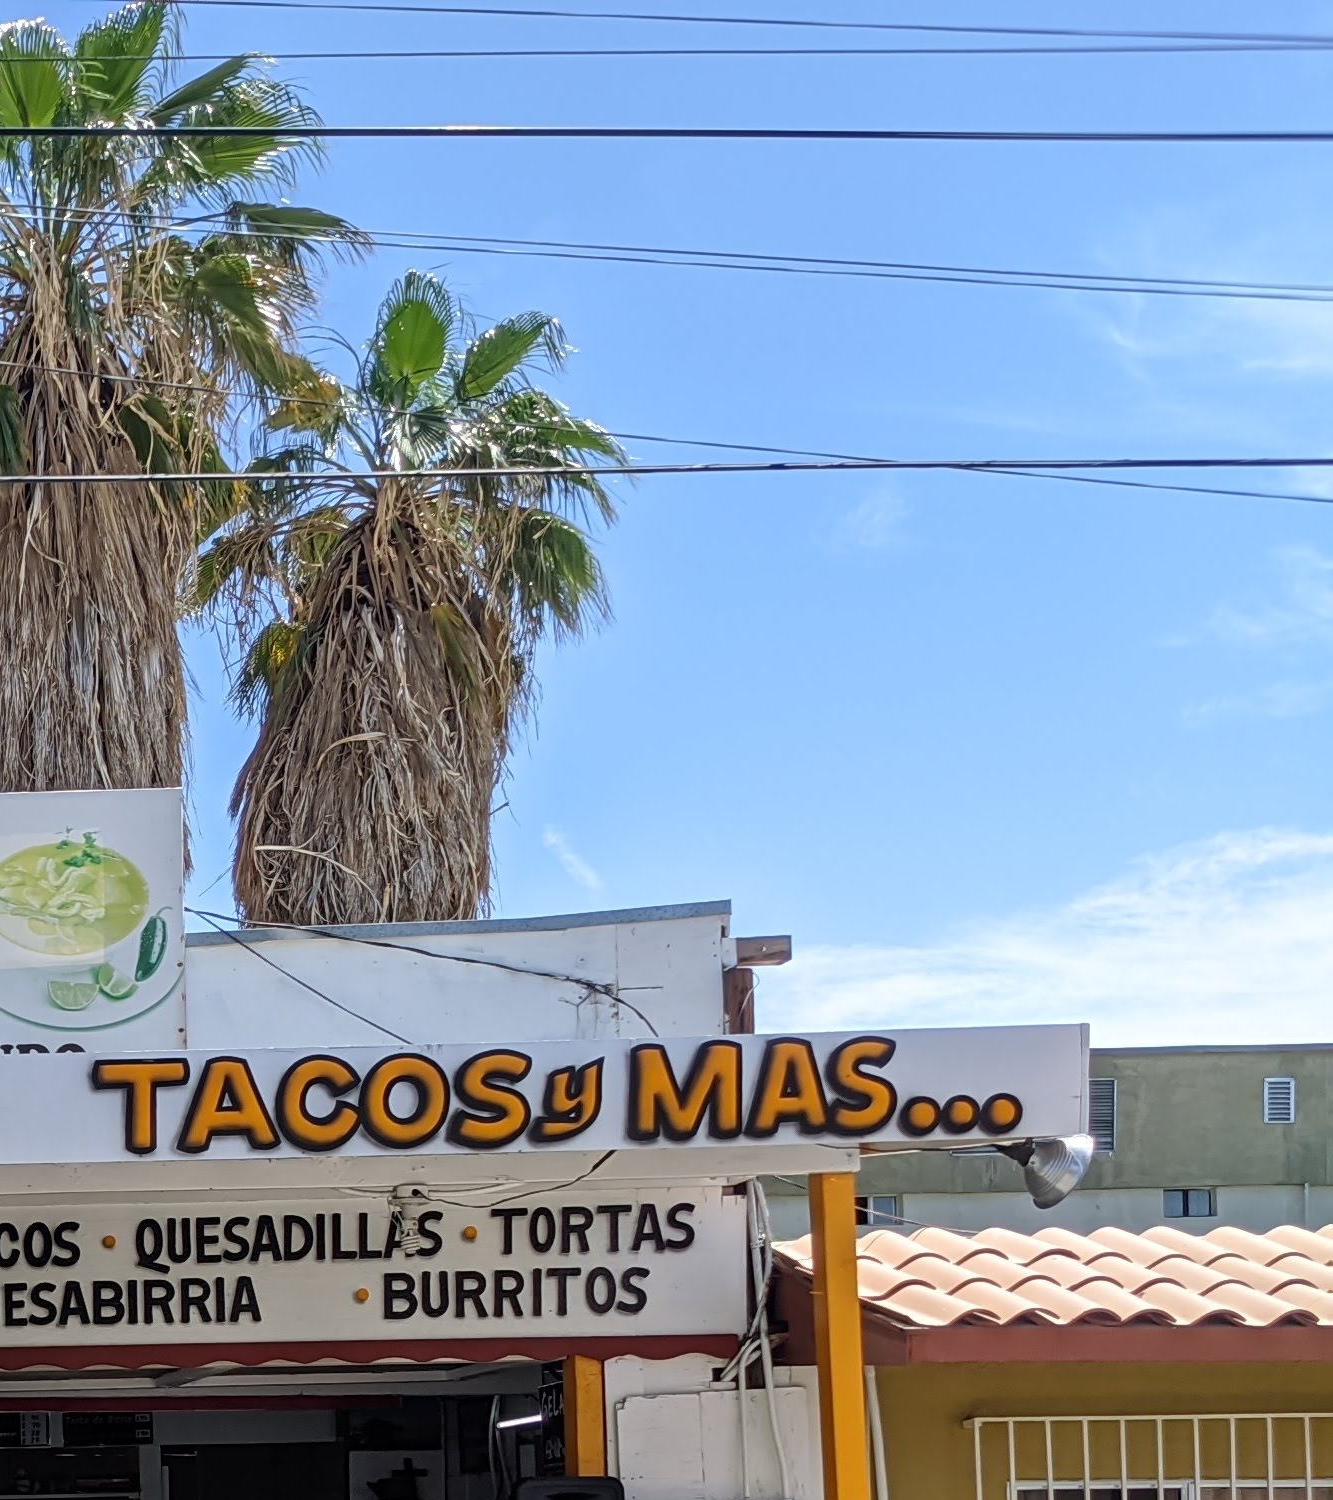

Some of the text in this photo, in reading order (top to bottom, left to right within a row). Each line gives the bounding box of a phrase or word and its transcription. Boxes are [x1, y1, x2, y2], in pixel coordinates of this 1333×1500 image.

[92, 1048, 533, 1155] TACOS
[533, 1055, 604, 1144] y
[135, 1209, 444, 1272] QUESADILLAS
[499, 1203, 695, 1256] TORTAS
[383, 1266, 649, 1320] BURRITOS
